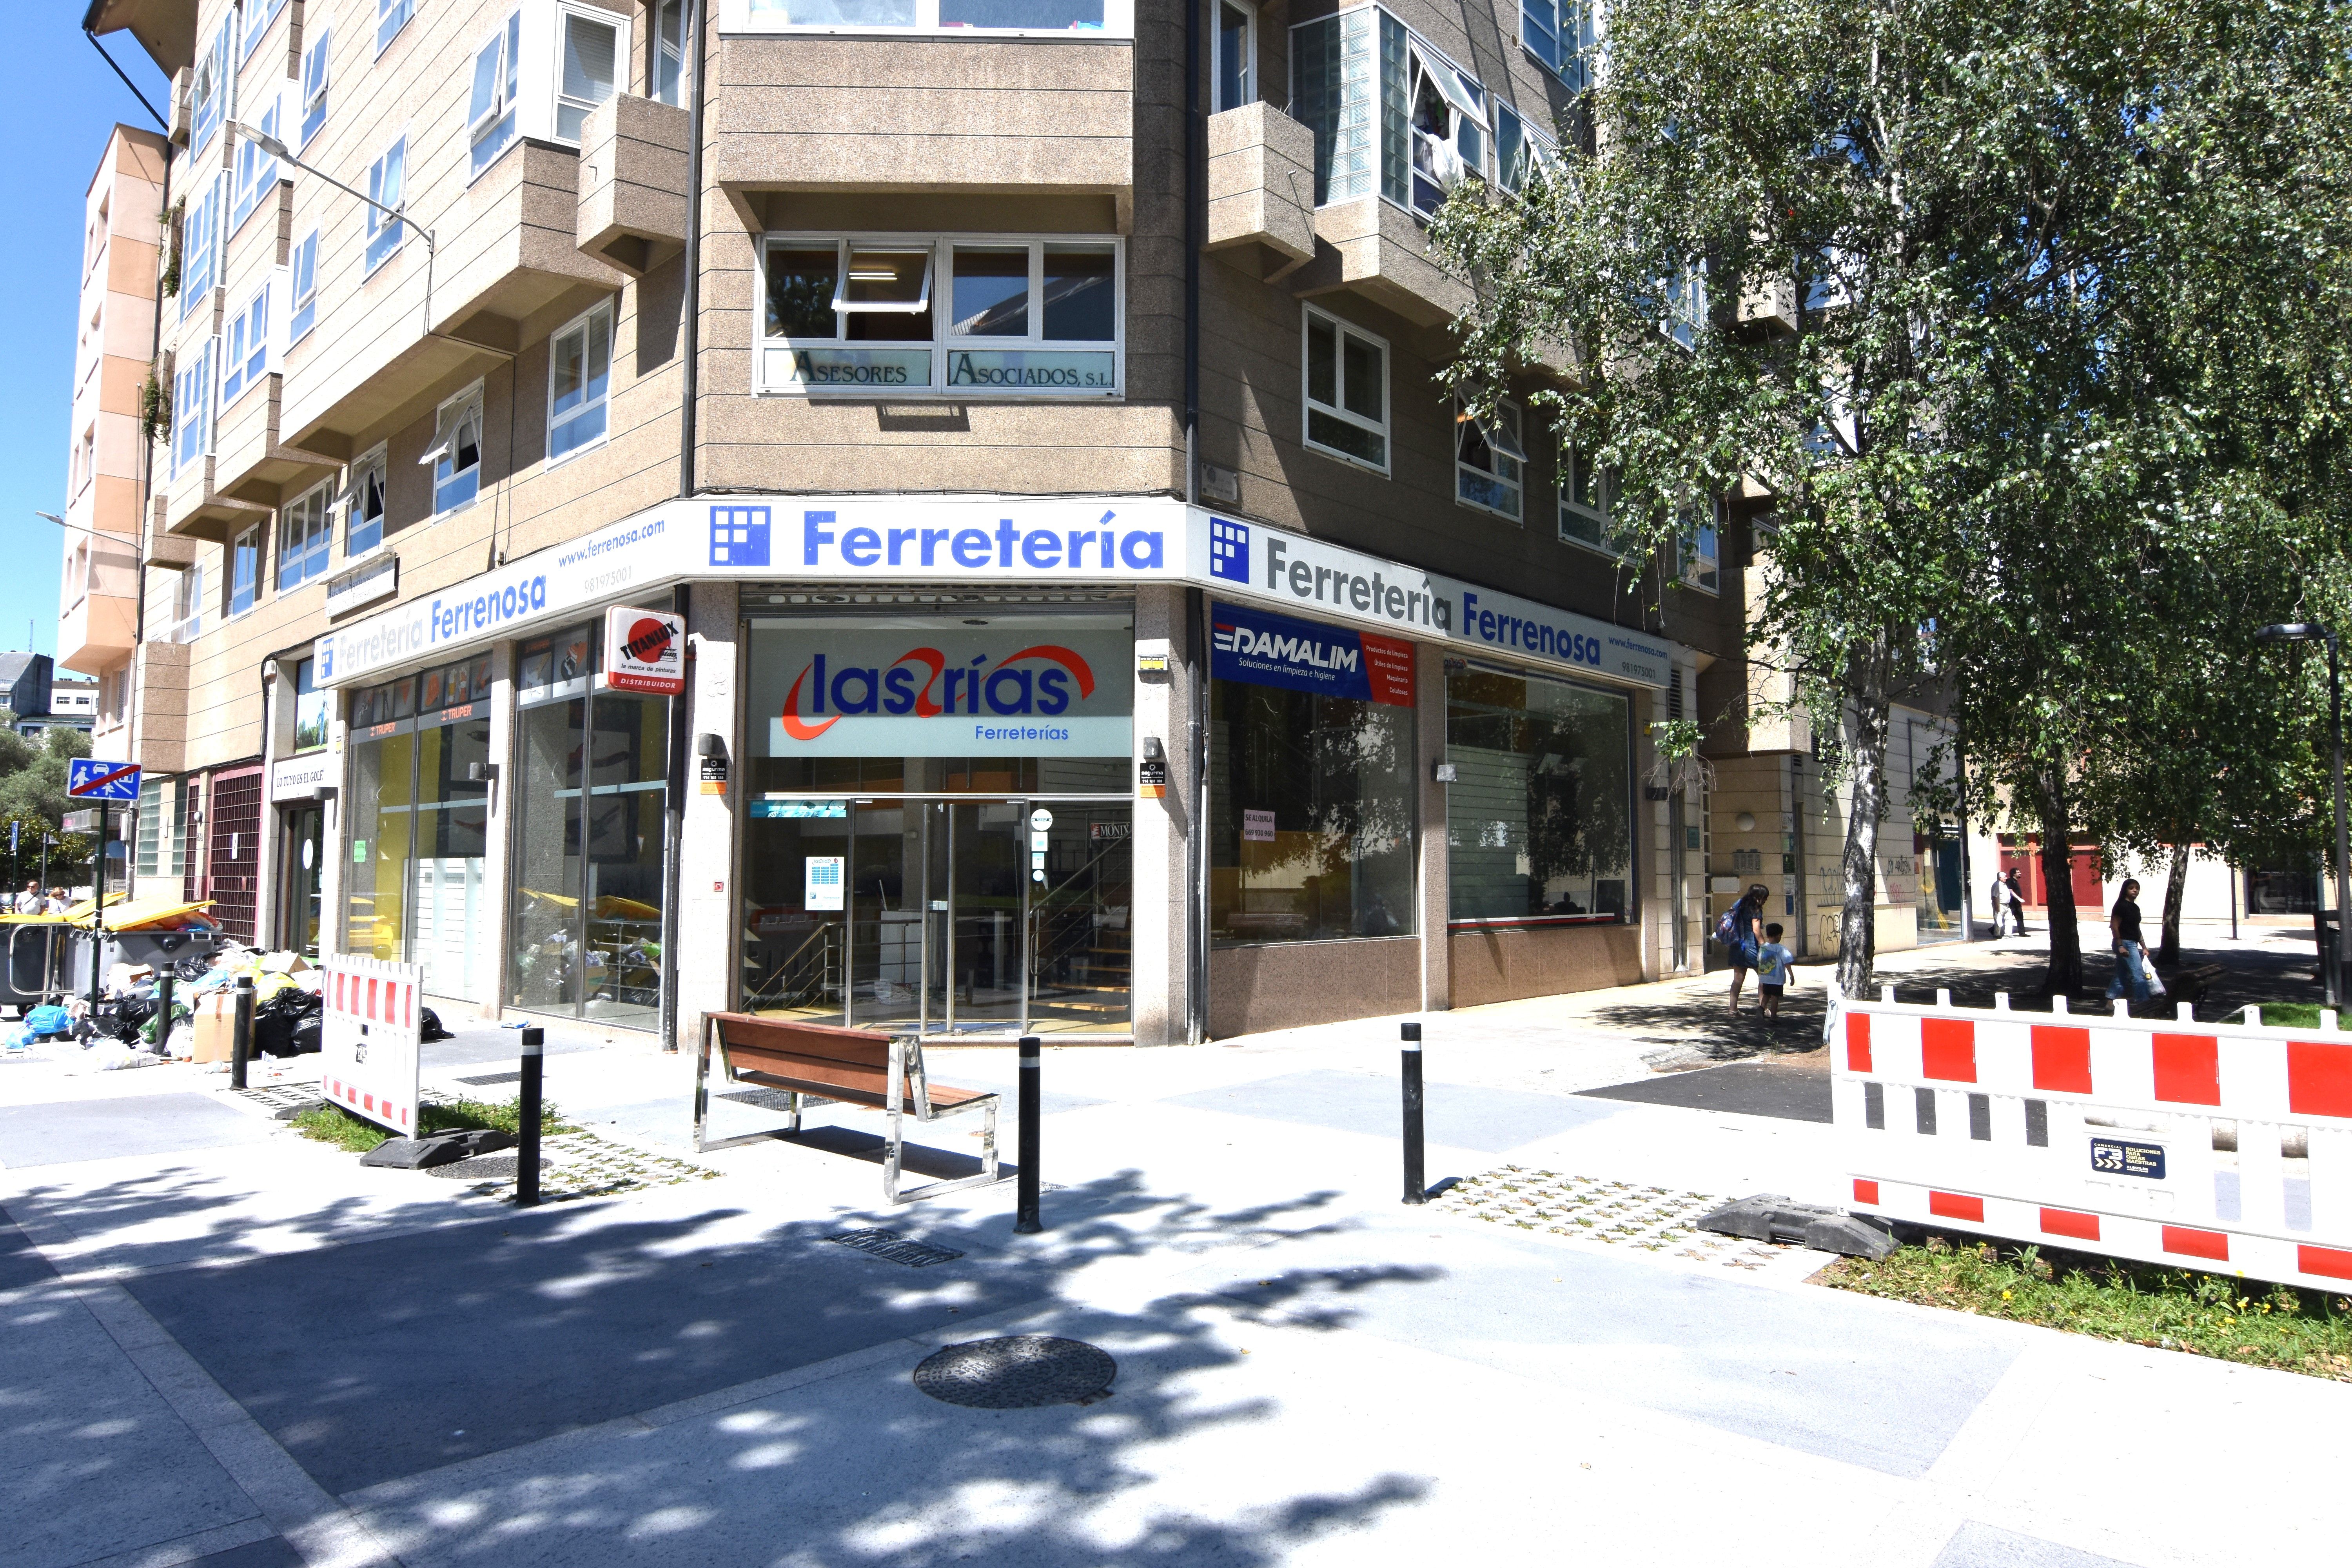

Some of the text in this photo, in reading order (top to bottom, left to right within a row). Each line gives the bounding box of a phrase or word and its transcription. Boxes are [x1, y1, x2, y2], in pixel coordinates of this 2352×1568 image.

[1085, 373, 1112, 386] S.L.
[559, 520, 664, 568] www.ferrenosa.com
[804, 510, 1163, 569] Ferretería
[584, 566, 631, 593] 981975001
[1267, 537, 1600, 666] Ferretería Ferrenosa
[339, 574, 546, 673] Ferretería Ferrenosa
[620, 621, 679, 660] TITANLUX
[1366, 645, 1386, 654] Productos
[1392, 650, 1408, 659] limpieza
[1608, 637, 1668, 659] www.ferrenosa.com
[1239, 657, 1272, 671] Soluciones
[1283, 664, 1308, 677] limpieza
[1314, 670, 1335, 681] higiene
[1374, 659, 1386, 667] Útiles
[1392, 662, 1408, 671] limpieza
[1622, 661, 1655, 679] 981975001
[1387, 674, 1408, 683] Maquinaria
[1389, 687, 1408, 695] Celulosas
[448, 706, 472, 719] TRUPER
[376, 722, 396, 735] TRUPER
[976, 725, 1069, 740] Ferreterías
[277, 777, 282, 787] LO
[284, 775, 296, 786] TUYO
[297, 774, 302, 784] ES
[304, 773, 309, 783] EL
[1100, 825, 1129, 837] MONIX
[2094, 1147, 2123, 1161] F3
